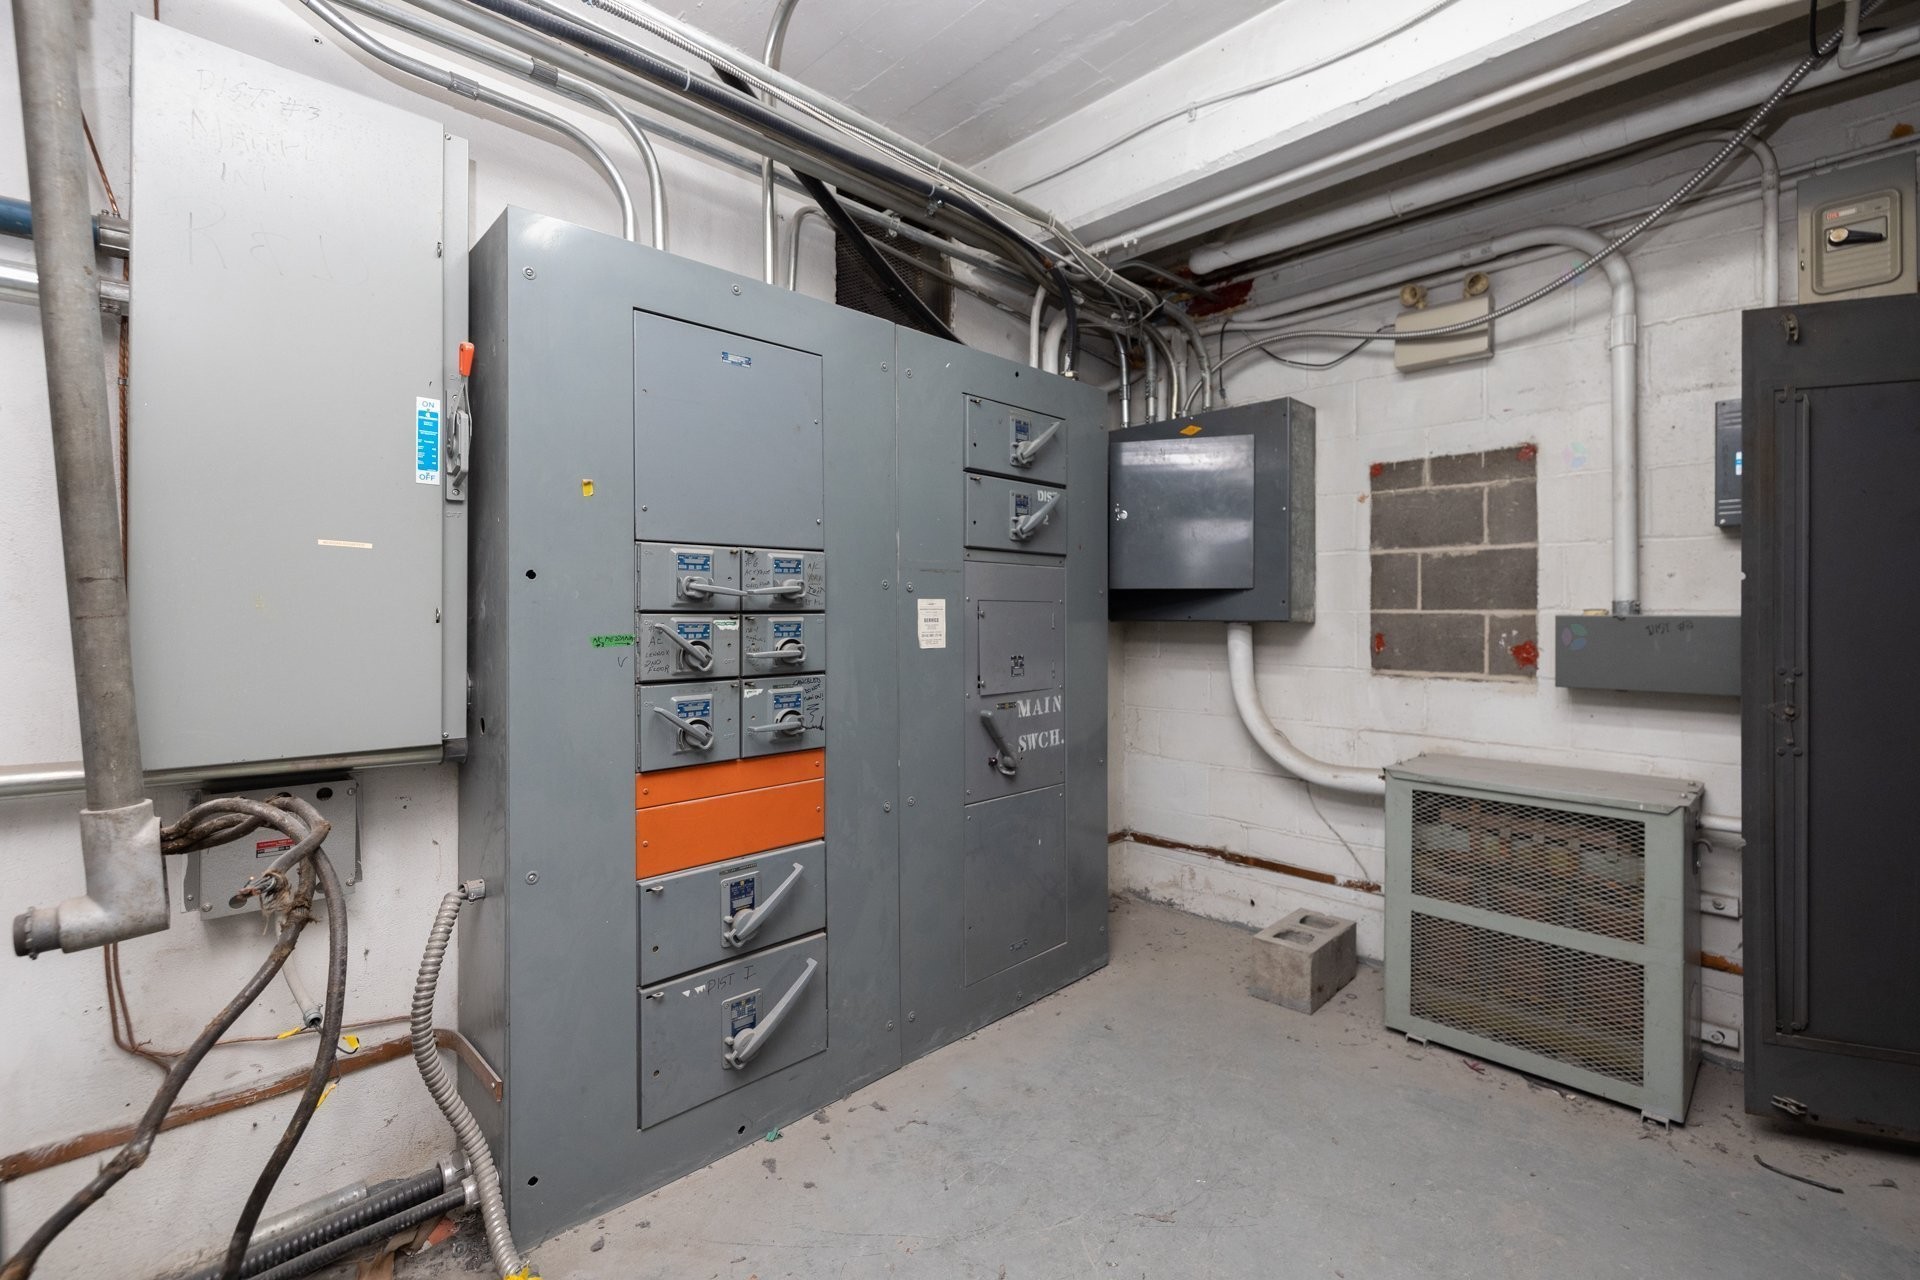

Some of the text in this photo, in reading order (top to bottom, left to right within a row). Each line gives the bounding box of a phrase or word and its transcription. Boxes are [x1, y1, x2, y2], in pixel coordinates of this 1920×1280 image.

[421, 400, 435, 408] ON
[419, 473, 436, 481] OFF
[1017, 695, 1063, 718] MAIN
[1018, 728, 1065, 753] SWCH.
